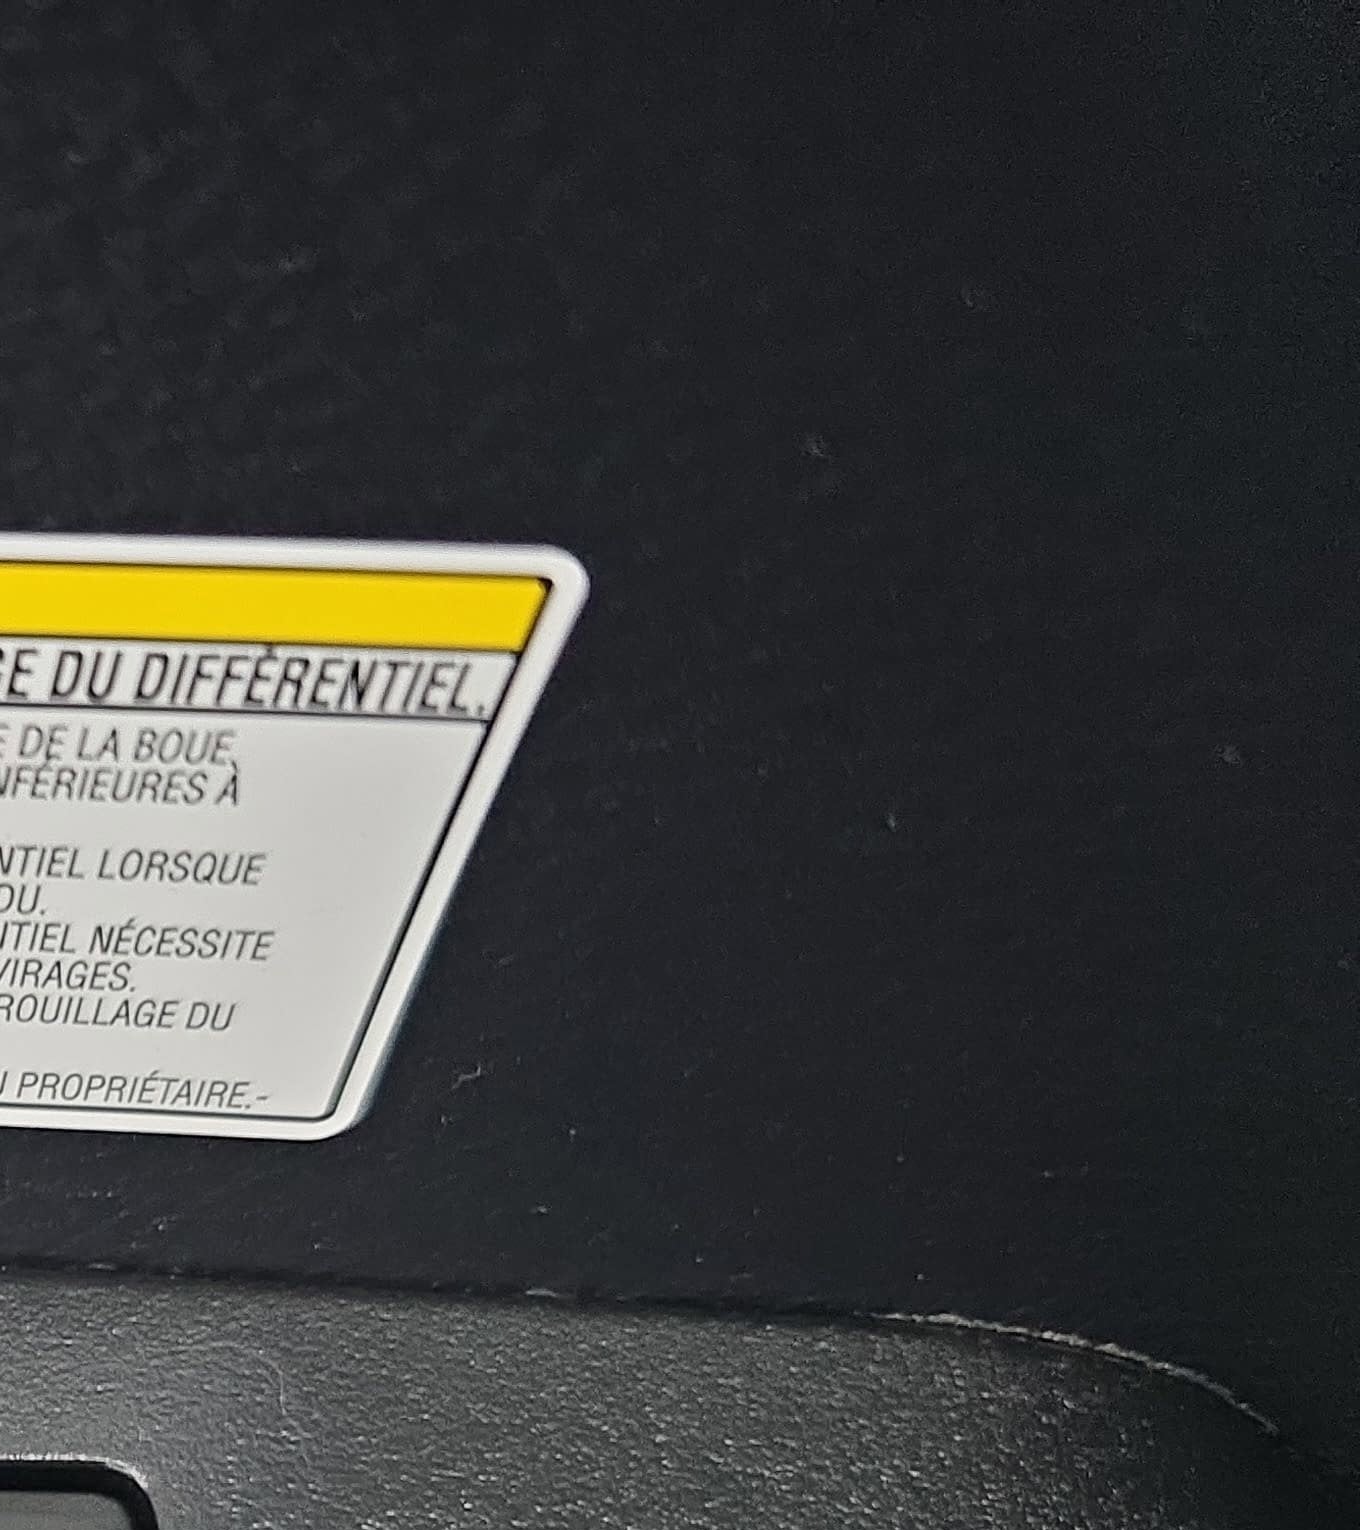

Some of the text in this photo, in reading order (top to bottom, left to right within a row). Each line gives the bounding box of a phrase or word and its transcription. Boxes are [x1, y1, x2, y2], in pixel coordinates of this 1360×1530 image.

[49, 649, 125, 703] DU
[76, 726, 121, 762] LA
[213, 763, 240, 807] À
[96, 848, 268, 887] LORSQUE
[87, 917, 276, 962] NÉCESSITE
